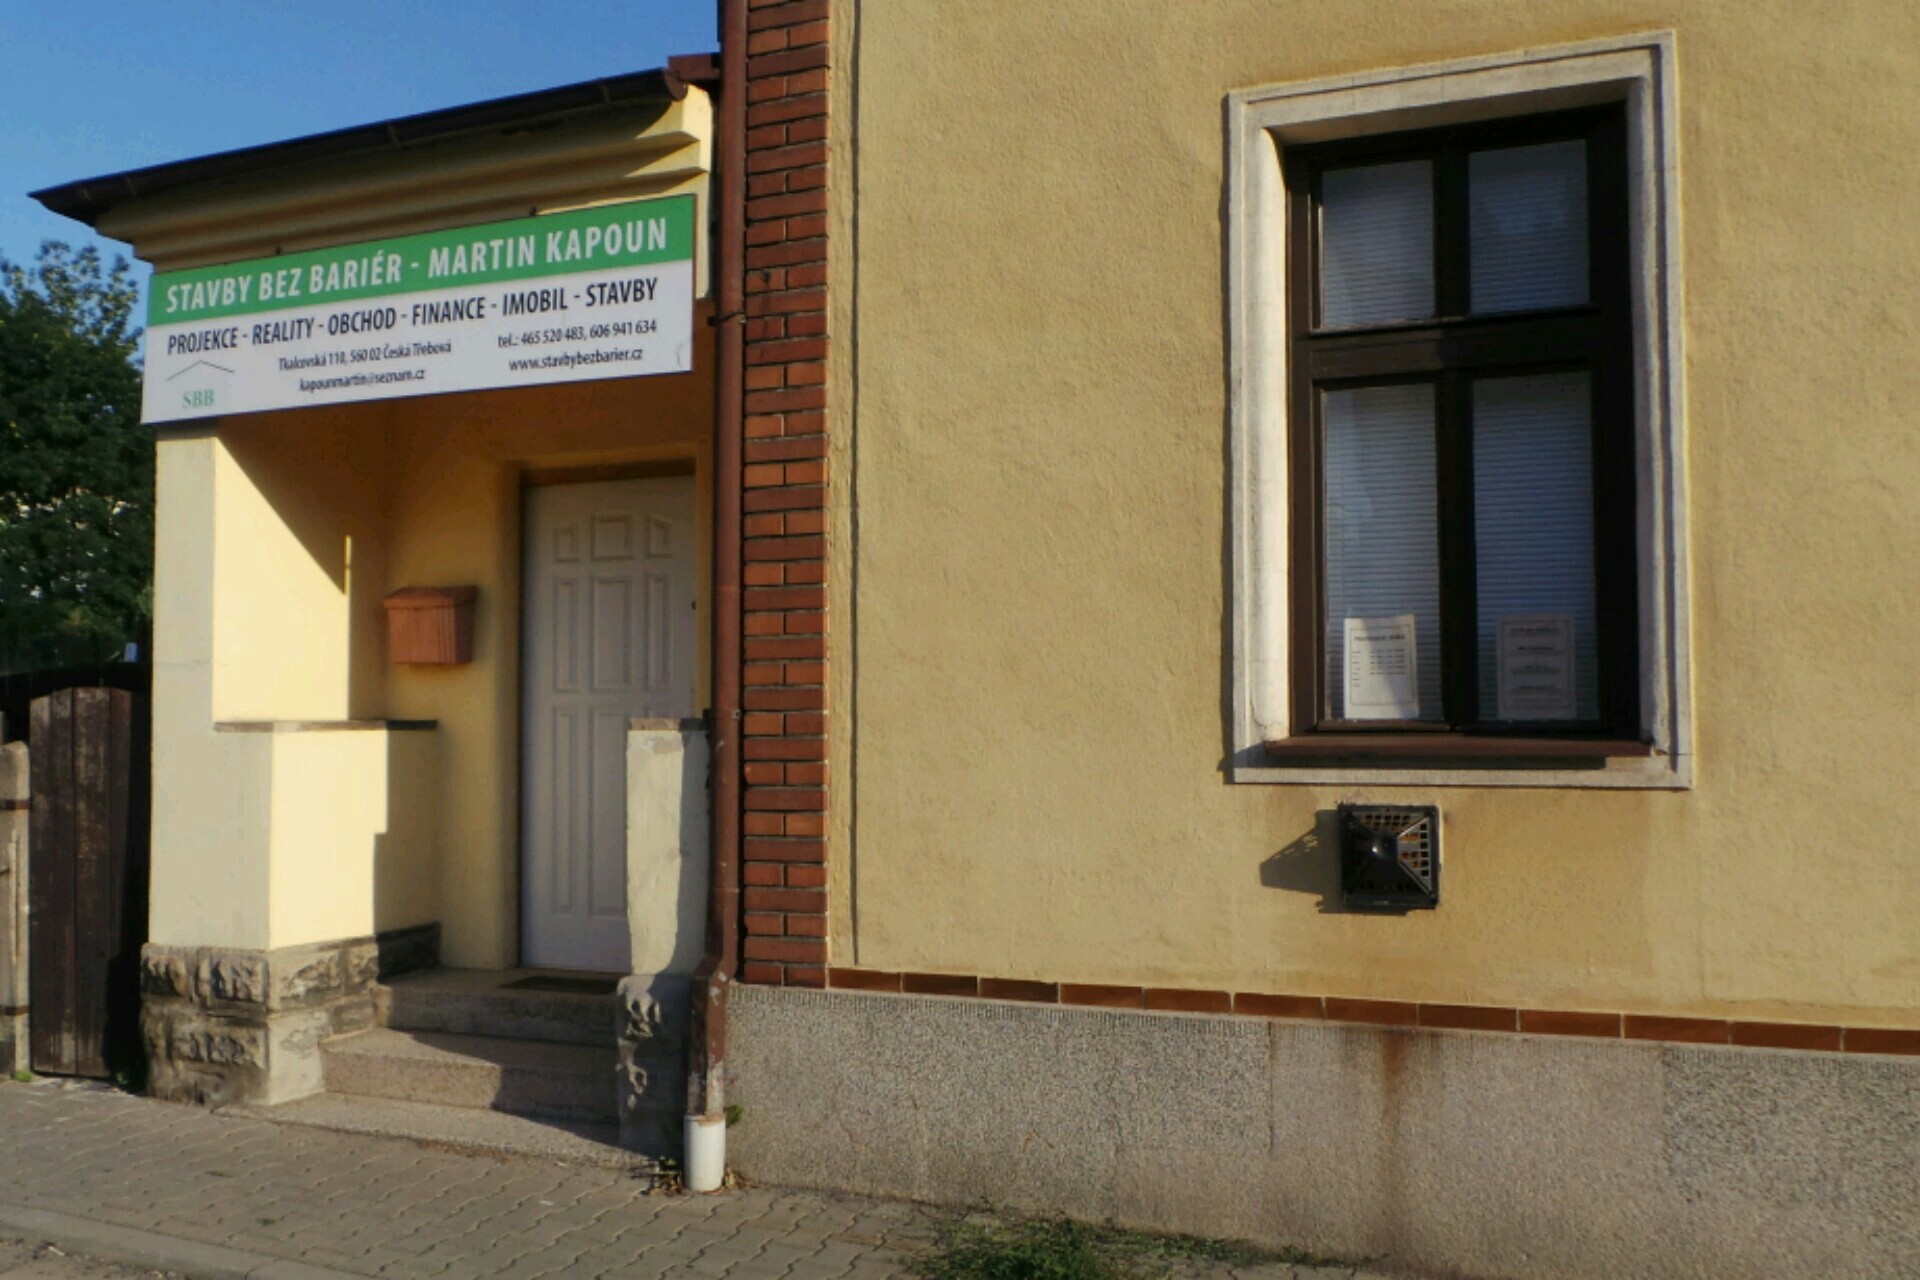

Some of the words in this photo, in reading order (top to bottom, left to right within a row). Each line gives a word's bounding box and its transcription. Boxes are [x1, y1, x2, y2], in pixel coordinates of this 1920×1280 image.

[166, 273, 252, 313] STAVBY
[259, 267, 301, 301] BEZ
[310, 250, 402, 295] BARIÉR
[428, 235, 535, 278] MARTIN
[546, 217, 667, 264] KAPOUN
[167, 327, 239, 356] PROJEKCE
[252, 318, 315, 345] REALITY
[328, 307, 396, 336] OBCHOD
[412, 296, 486, 326] FINANCE
[502, 287, 568, 317] IMOBIL
[585, 276, 658, 307] STAVBY
[521, 330, 541, 345] 465
[543, 328, 562, 343] 520
[589, 323, 610, 338] 606
[613, 321, 633, 336] 941
[635, 319, 657, 334] 634
[383, 342, 411, 360] Česká
[412, 339, 452, 358] Třebová
[509, 348, 643, 371] www.stavbybezbarier.cz
[182, 389, 214, 408] SBB
